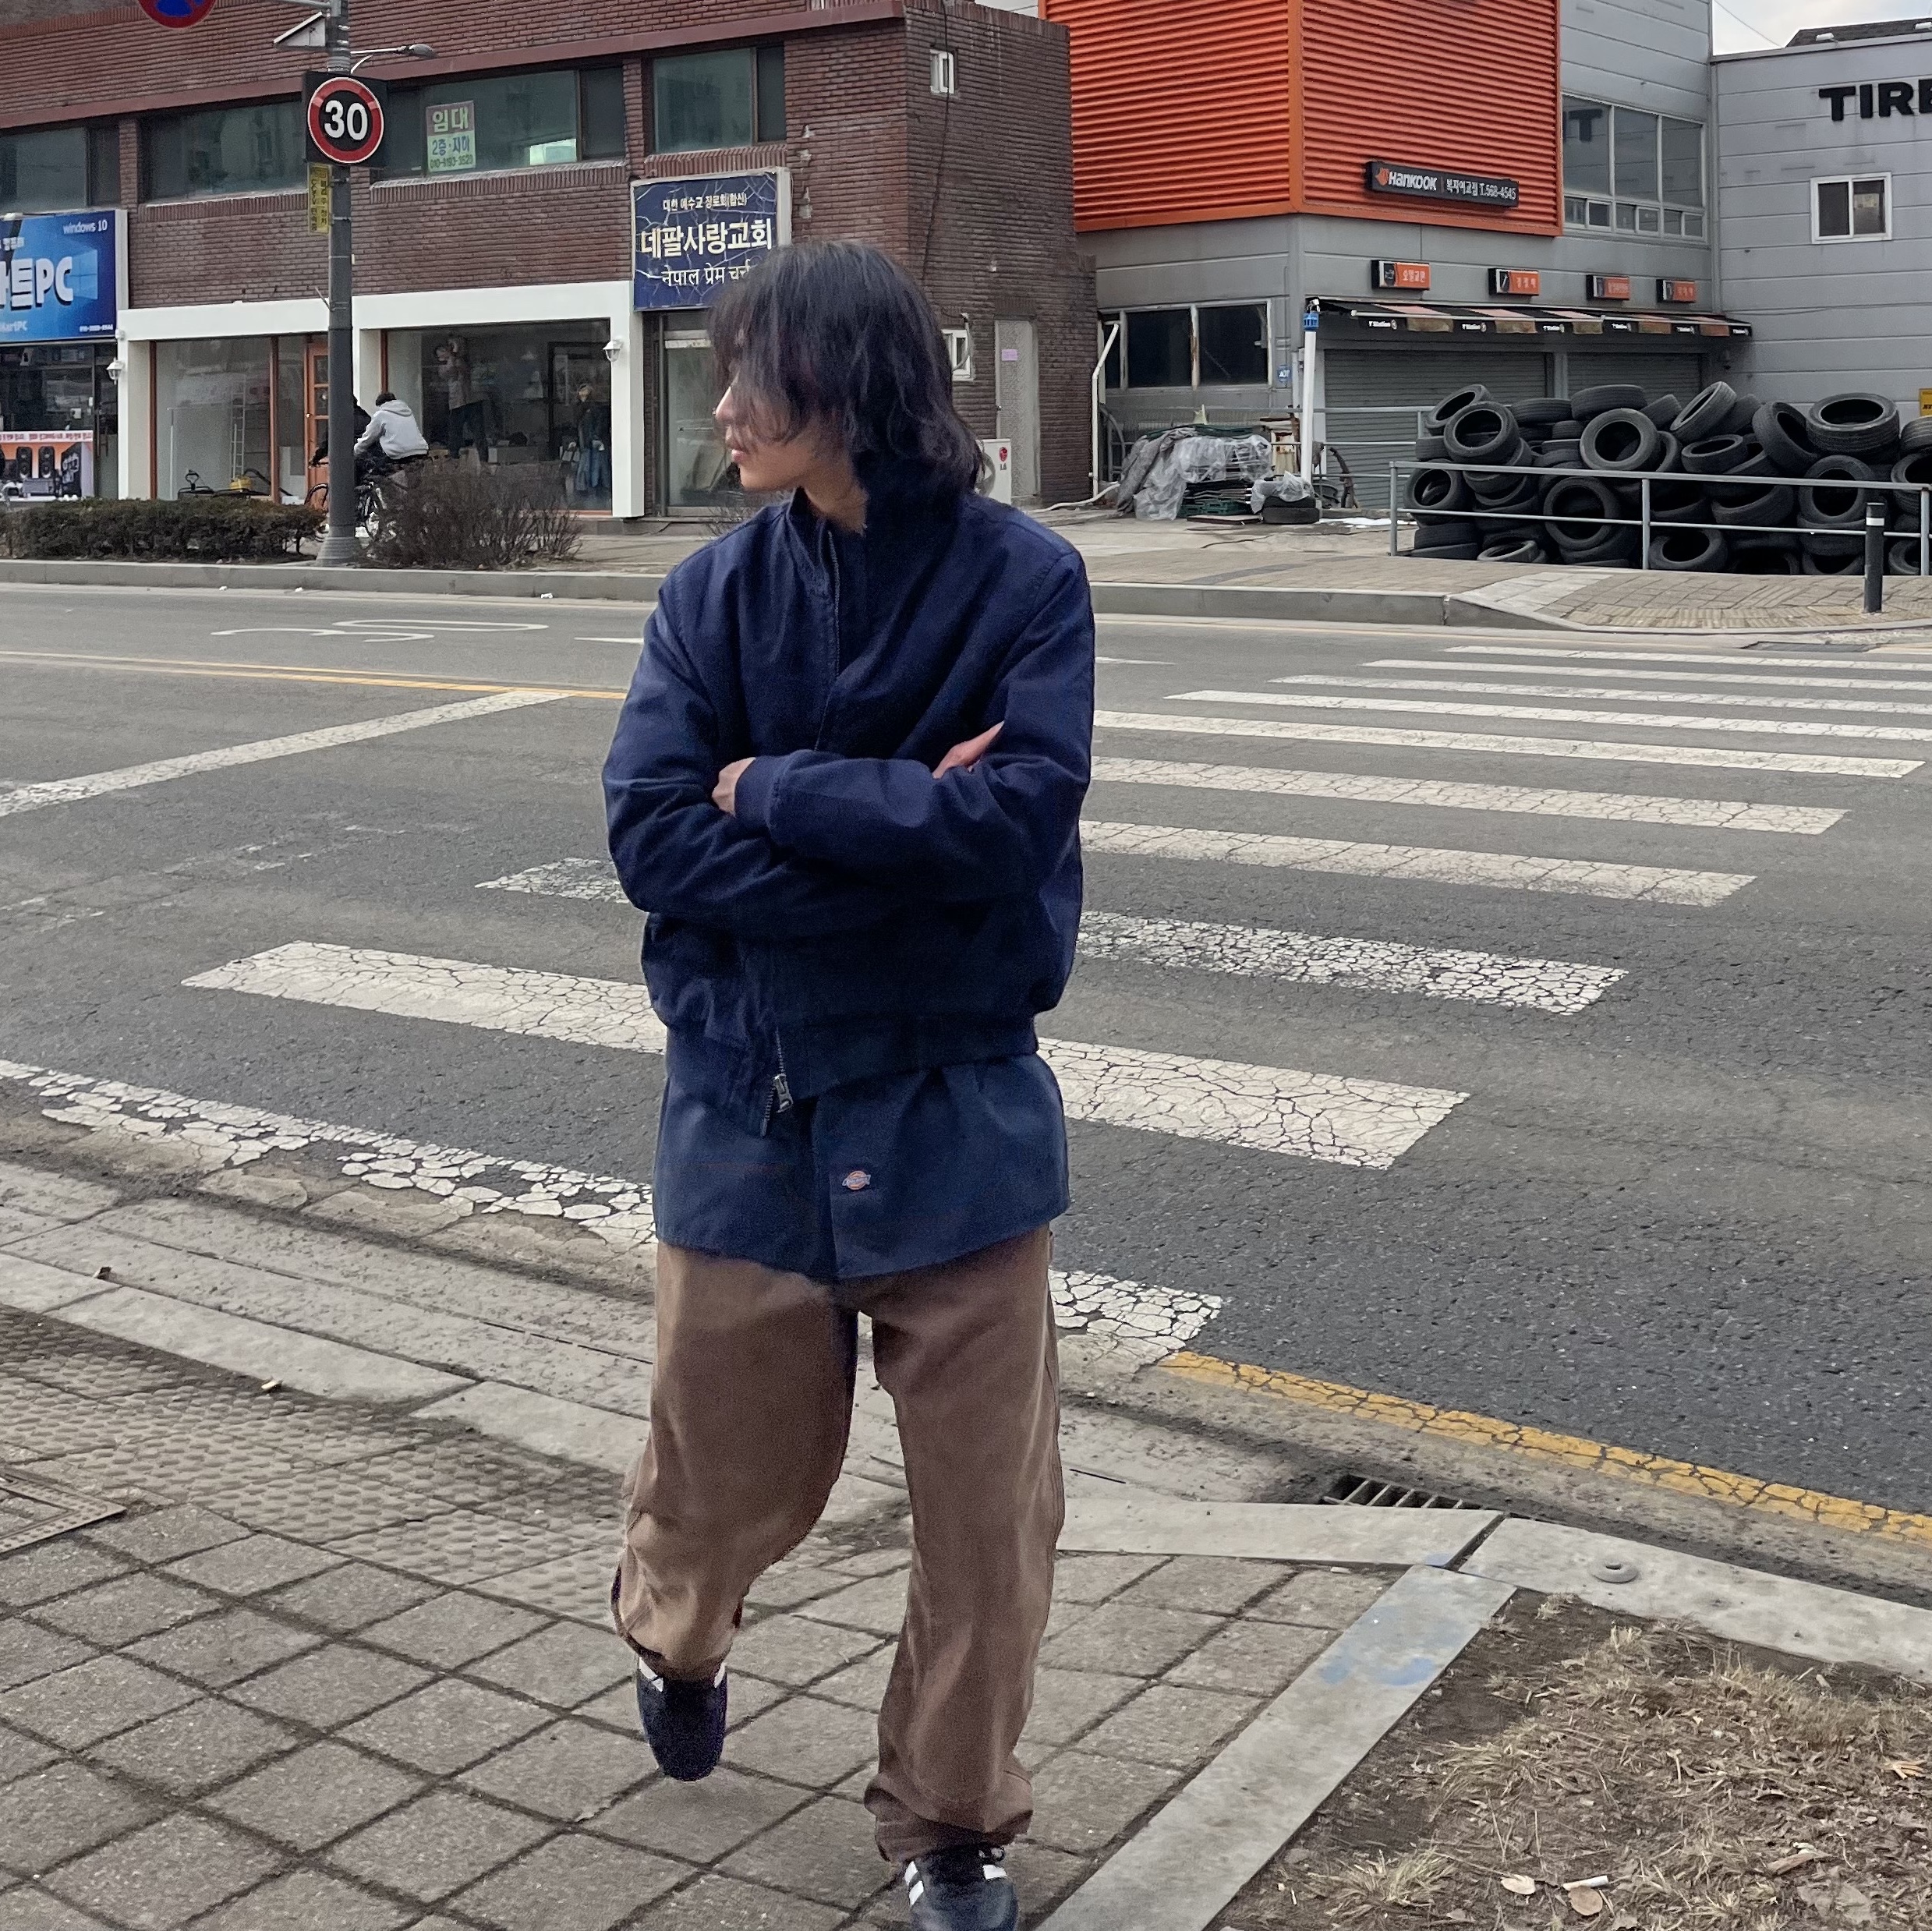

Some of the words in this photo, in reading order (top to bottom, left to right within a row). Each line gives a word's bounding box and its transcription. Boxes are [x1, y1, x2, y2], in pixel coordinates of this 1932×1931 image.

[324, 100, 368, 140] 30
[432, 107, 469, 133] 임대
[1388, 171, 1438, 191] Hankook
[663, 200, 678, 212] 대한
[680, 197, 703, 210] 예수교
[97, 219, 108, 232] 10
[641, 218, 773, 260] 네팔사랑교회
[661, 263, 700, 287] नेपाल
